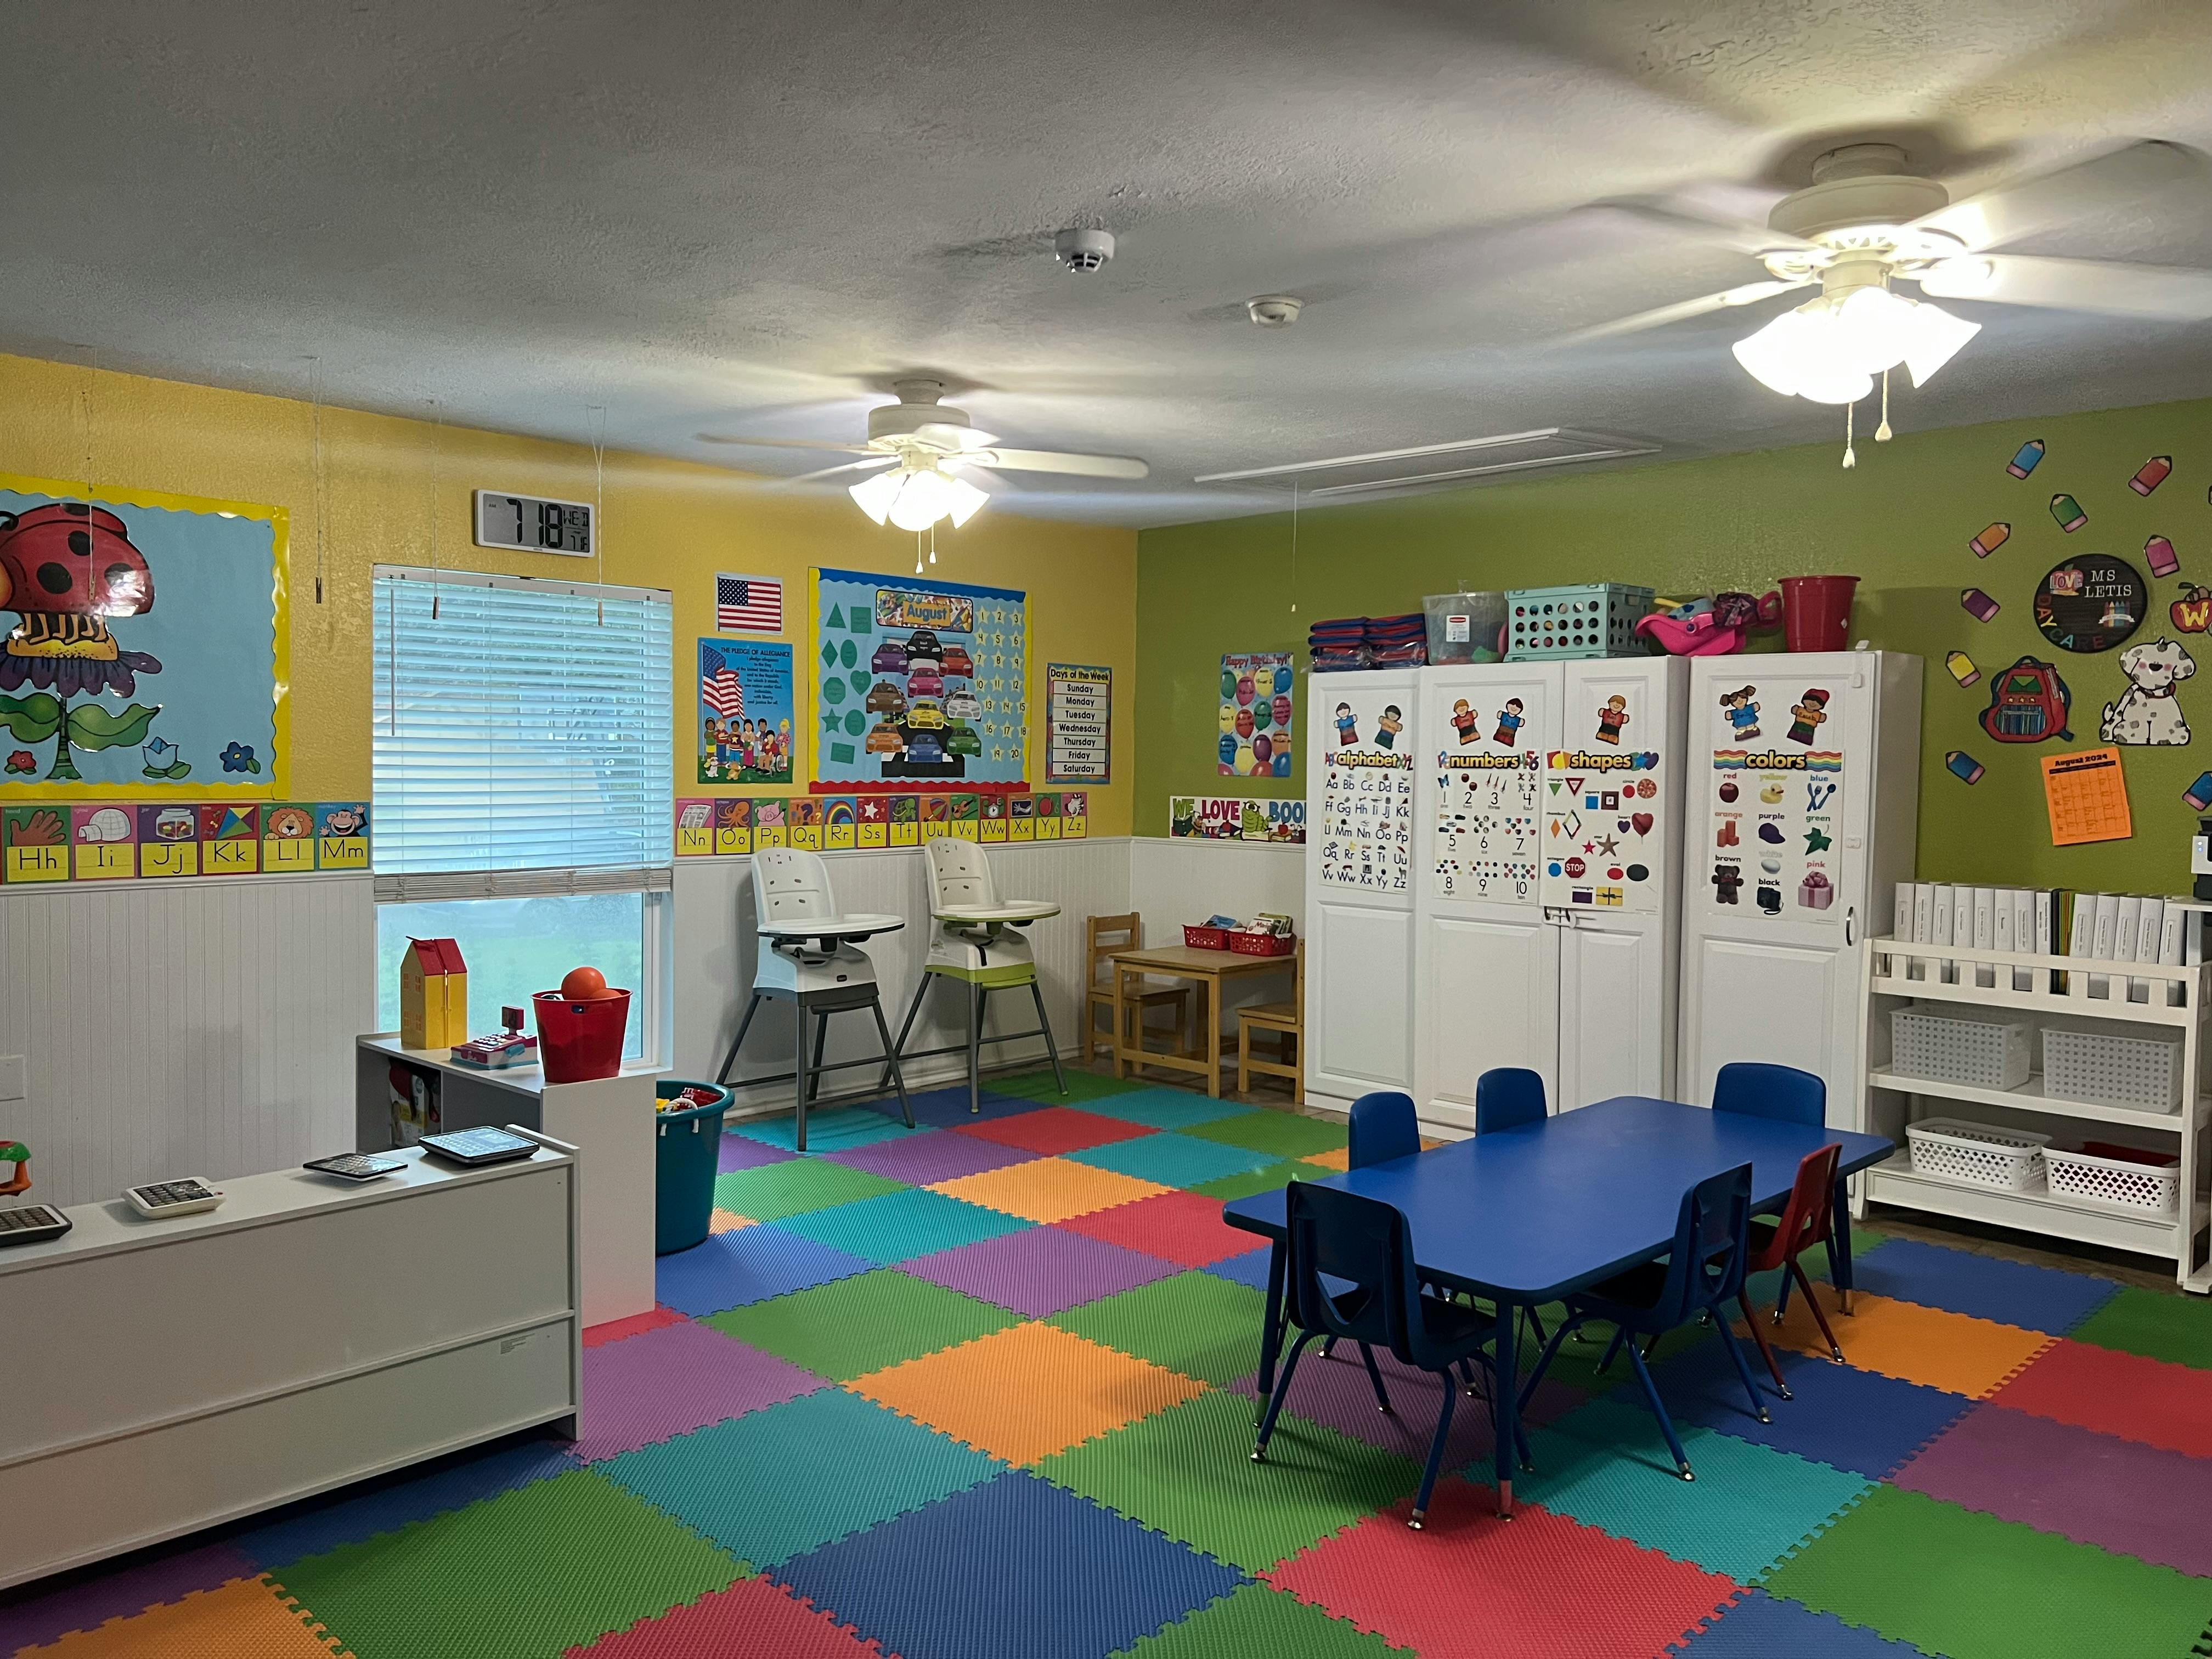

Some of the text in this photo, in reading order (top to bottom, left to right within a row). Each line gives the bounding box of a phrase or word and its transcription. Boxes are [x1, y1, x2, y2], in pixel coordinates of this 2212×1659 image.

[2050, 573, 2083, 589] LOVE
[2085, 585, 2132, 597] LETIS
[906, 605, 947, 621] August
[997, 612, 1001, 620] 2
[2180, 602, 2209, 627] W
[1014, 636, 1018, 645] 6
[977, 654, 1018, 667] 7 8 9
[1051, 669, 1068, 679] Days
[1091, 672, 1109, 681] Week
[977, 680, 983, 689] 10
[1012, 681, 1018, 689] 12
[1067, 684, 1093, 694] Sunday
[985, 701, 991, 709] 13
[1066, 697, 1094, 707] Monday
[1065, 710, 1095, 720] Tuesday
[986, 725, 992, 733] 16
[1004, 726, 1010, 735] 17
[1059, 724, 1101, 734] Wednesday
[1064, 737, 1096, 747] Thursday
[1011, 749, 1019, 758] 20
[1069, 751, 1090, 761] Friday
[1338, 751, 1398, 769] alphabet
[1451, 752, 1519, 768] numbers
[1746, 751, 1805, 768] colors
[2055, 754, 2107, 766] August 2024
[1571, 752, 1631, 772] shapes
[1064, 765, 1095, 774] Saturday
[1326, 779, 1410, 793] Aa Bb Cc Dd Ee
[1443, 791, 1531, 805] 1 2 3 4
[1173, 798, 1306, 824] WE LOVE BOO
[1325, 802, 1409, 819] Ff Gg Hh Ii Jj Kk
[684, 817, 1081, 849] Nn Oo Pp Qq Rr Ss Tt Uu Vv Ww Xx Yy Zz
[1335, 826, 1352, 837] Mm
[1357, 828, 1370, 838] Nn
[1376, 829, 1391, 840] Oo
[1396, 831, 1408, 844] Pp
[1449, 834, 1524, 850] 5 6 7
[20, 839, 363, 874] Hh Ii Jj Kk Ll Mm
[1323, 847, 1407, 865] Qq Rr Ss Tt Uu
[1566, 863, 1584, 872] STOP
[1322, 870, 1406, 889] Vv Ww Xx Yy Zz
[1446, 877, 1527, 894] 8 9 10
